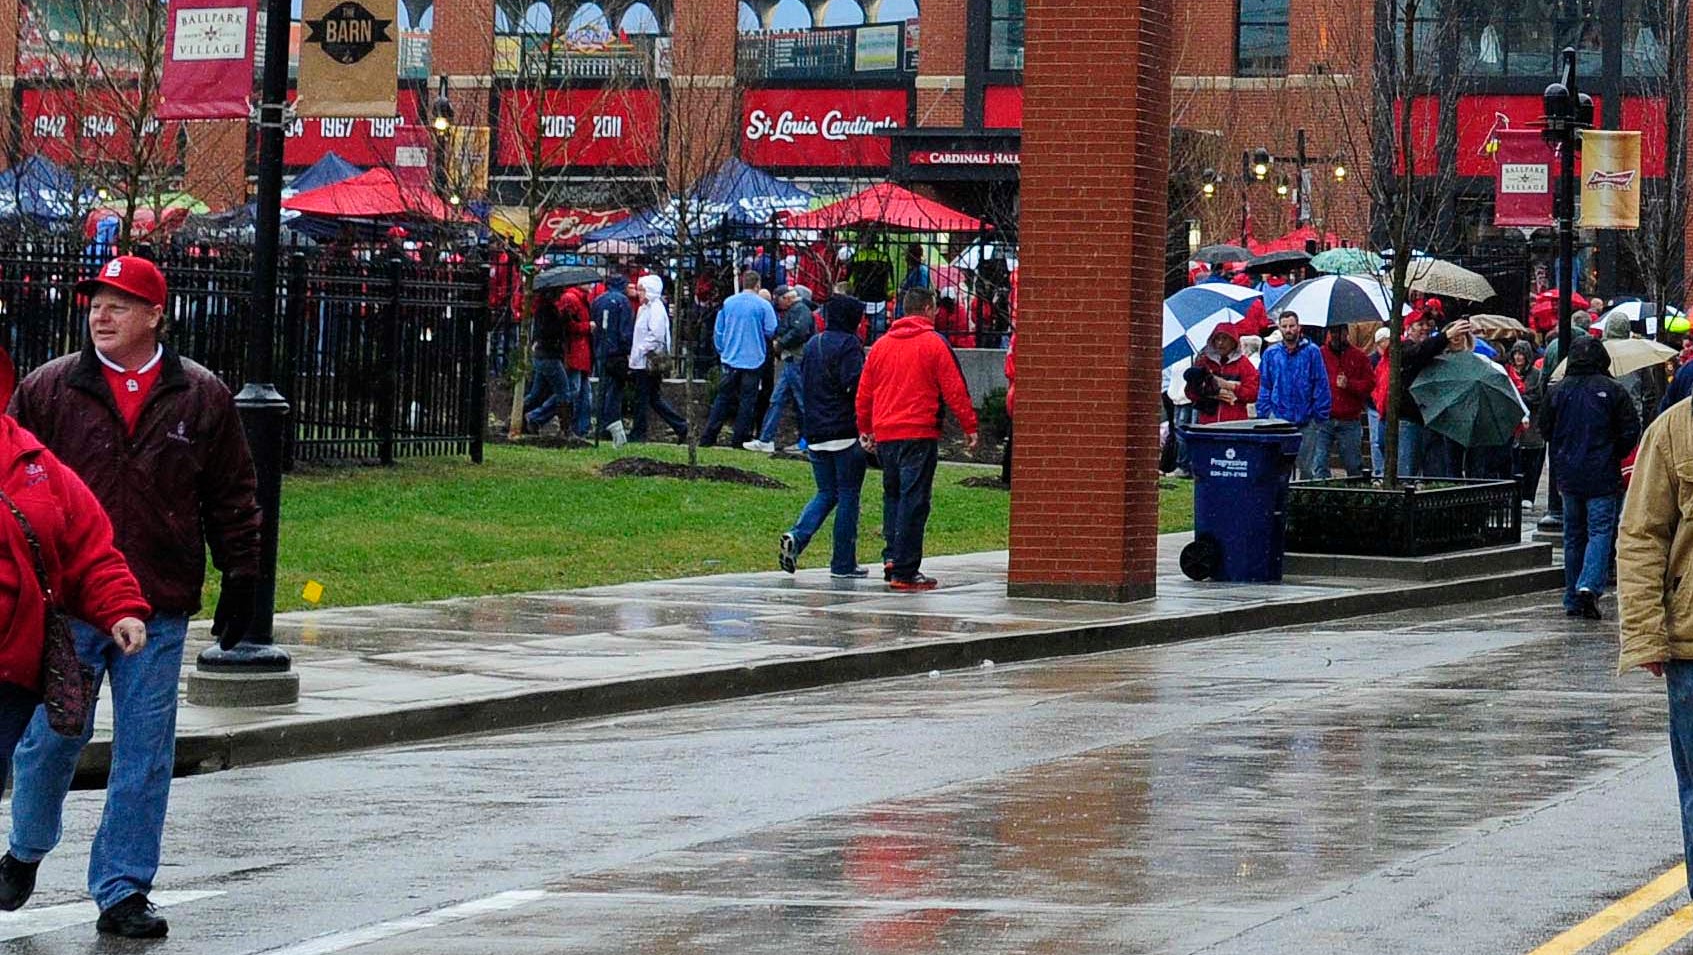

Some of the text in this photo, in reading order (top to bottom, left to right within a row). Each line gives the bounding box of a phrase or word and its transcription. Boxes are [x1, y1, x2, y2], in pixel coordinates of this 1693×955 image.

[181, 12, 243, 27] BALLPARK
[326, 19, 372, 43] BARN
[179, 43, 241, 55] VILLAGE
[33, 115, 67, 137] 1942
[82, 115, 116, 137] 1944
[320, 117, 354, 137] 1967
[593, 115, 622, 137] 2011
[929, 152, 1021, 165] CARDINALS HALL
